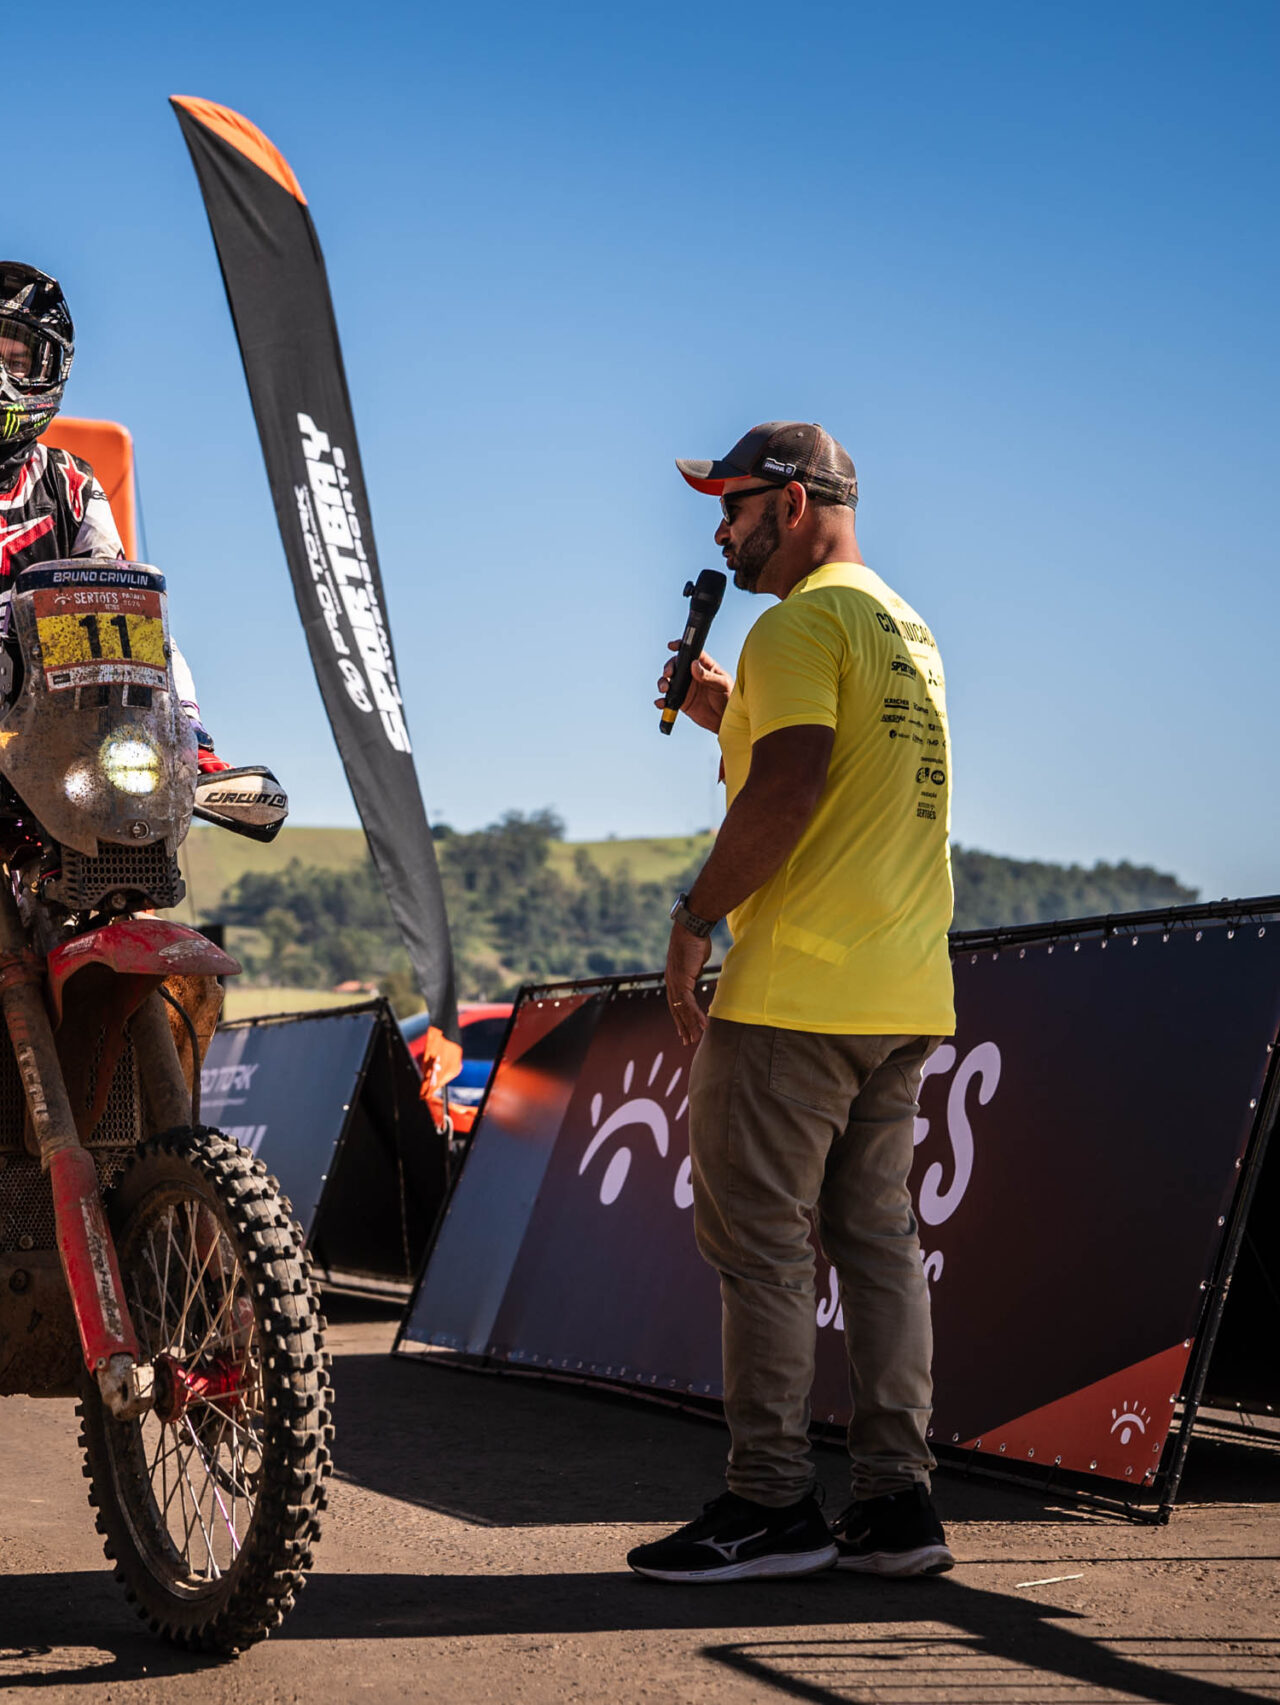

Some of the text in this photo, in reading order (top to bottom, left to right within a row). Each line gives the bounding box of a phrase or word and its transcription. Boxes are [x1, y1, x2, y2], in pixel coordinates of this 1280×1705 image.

[52, 571, 149, 586] BRUNO CRIVILIN
[296, 411, 412, 754] SPORTBAY
[78, 615, 132, 659] 11
[316, 583, 351, 656] PRO
[204, 792, 271, 806] CIRCUIT
